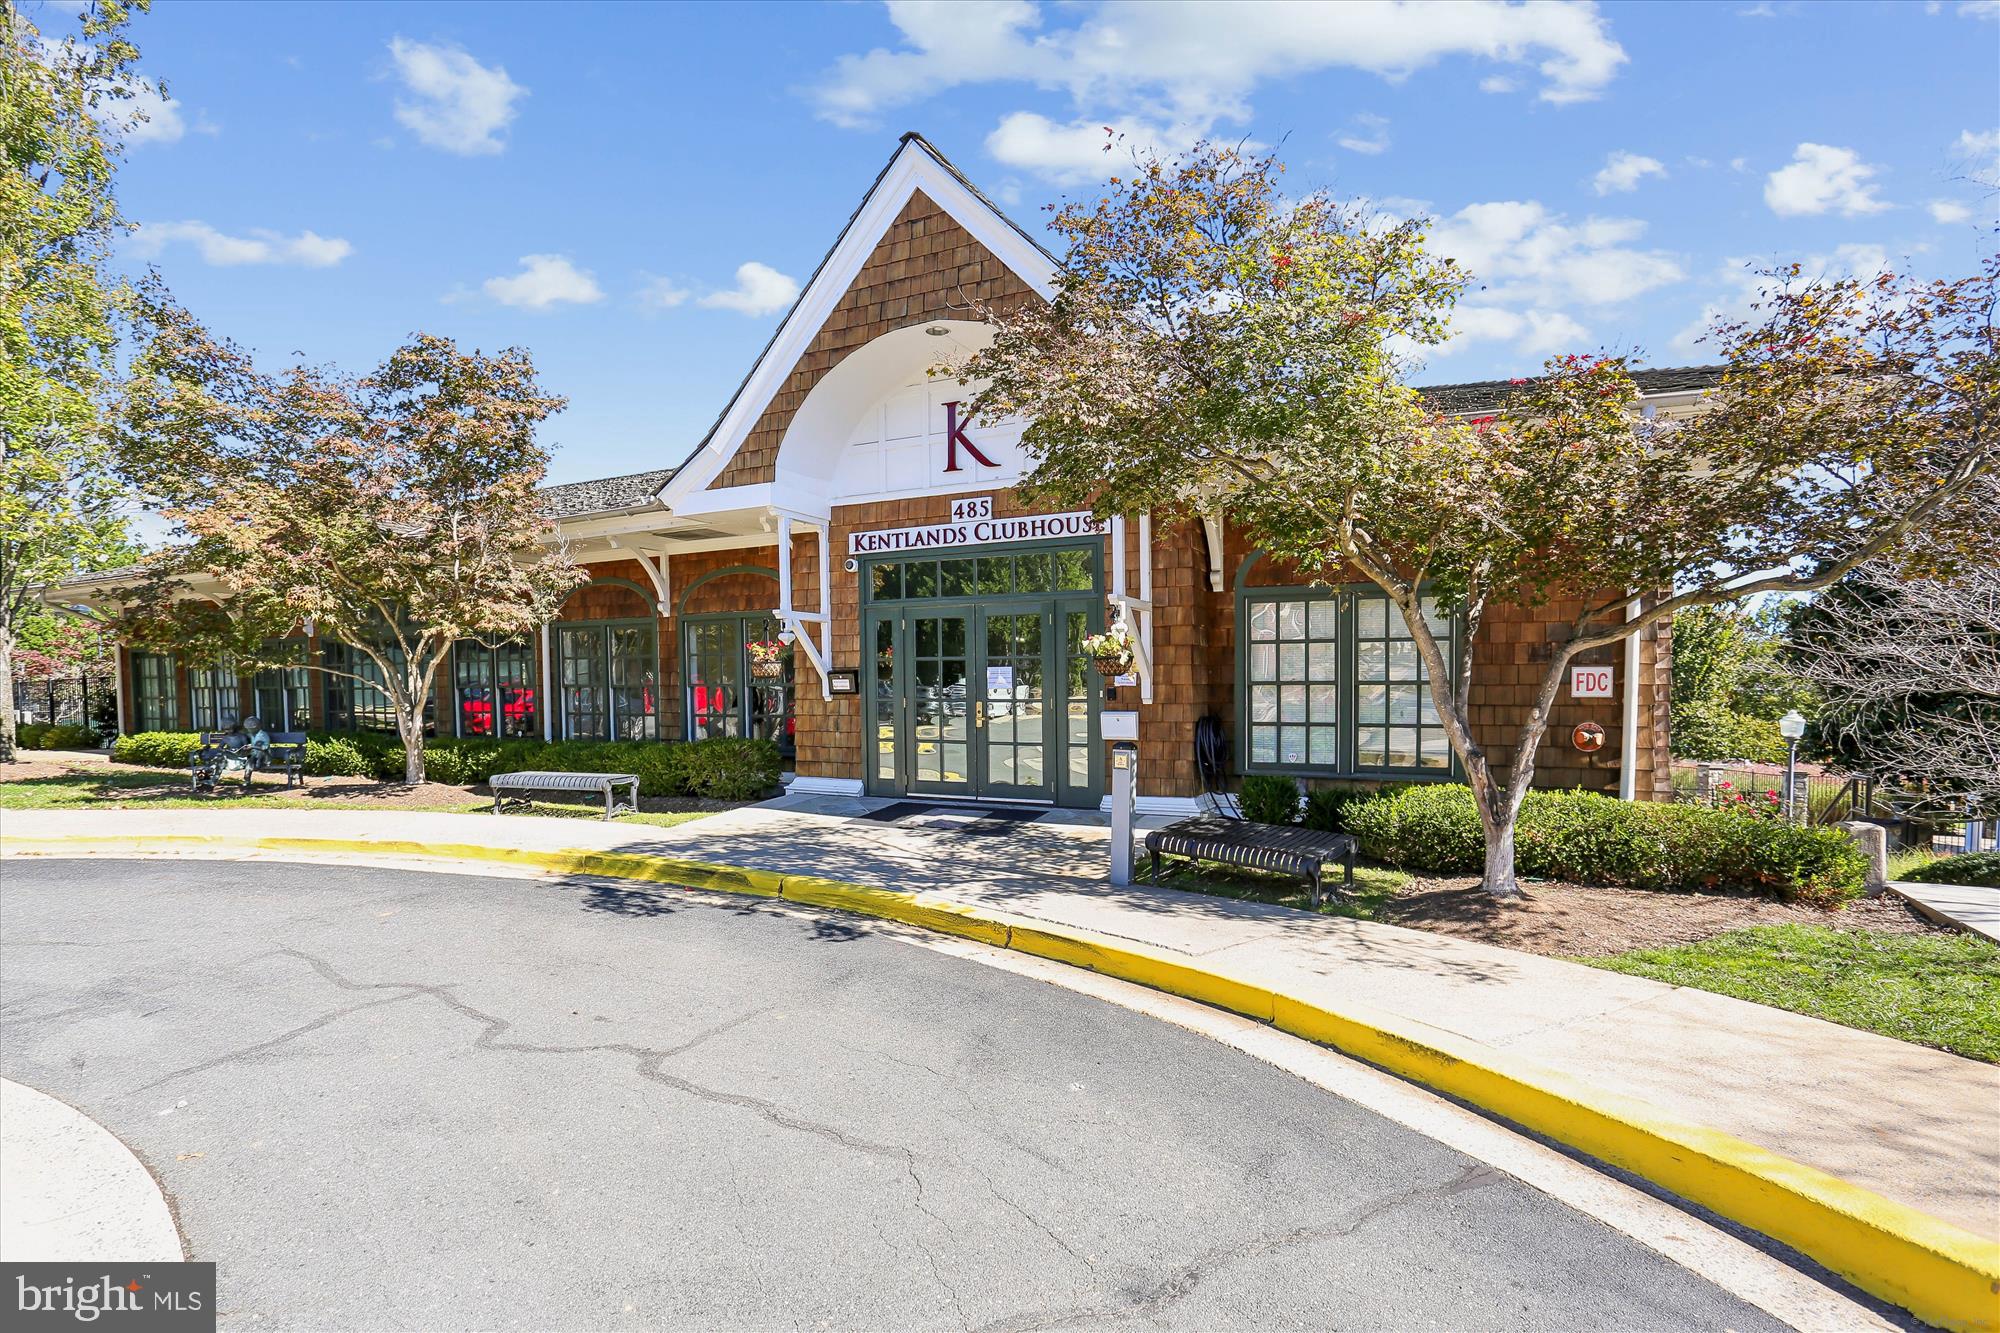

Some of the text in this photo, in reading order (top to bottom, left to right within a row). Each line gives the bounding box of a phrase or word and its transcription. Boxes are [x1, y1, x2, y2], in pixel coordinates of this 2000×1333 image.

[941, 401, 1001, 472] K
[953, 500, 989, 519] 485
[854, 526, 967, 552] KENTLANDS
[1576, 673, 1608, 692] FDC
